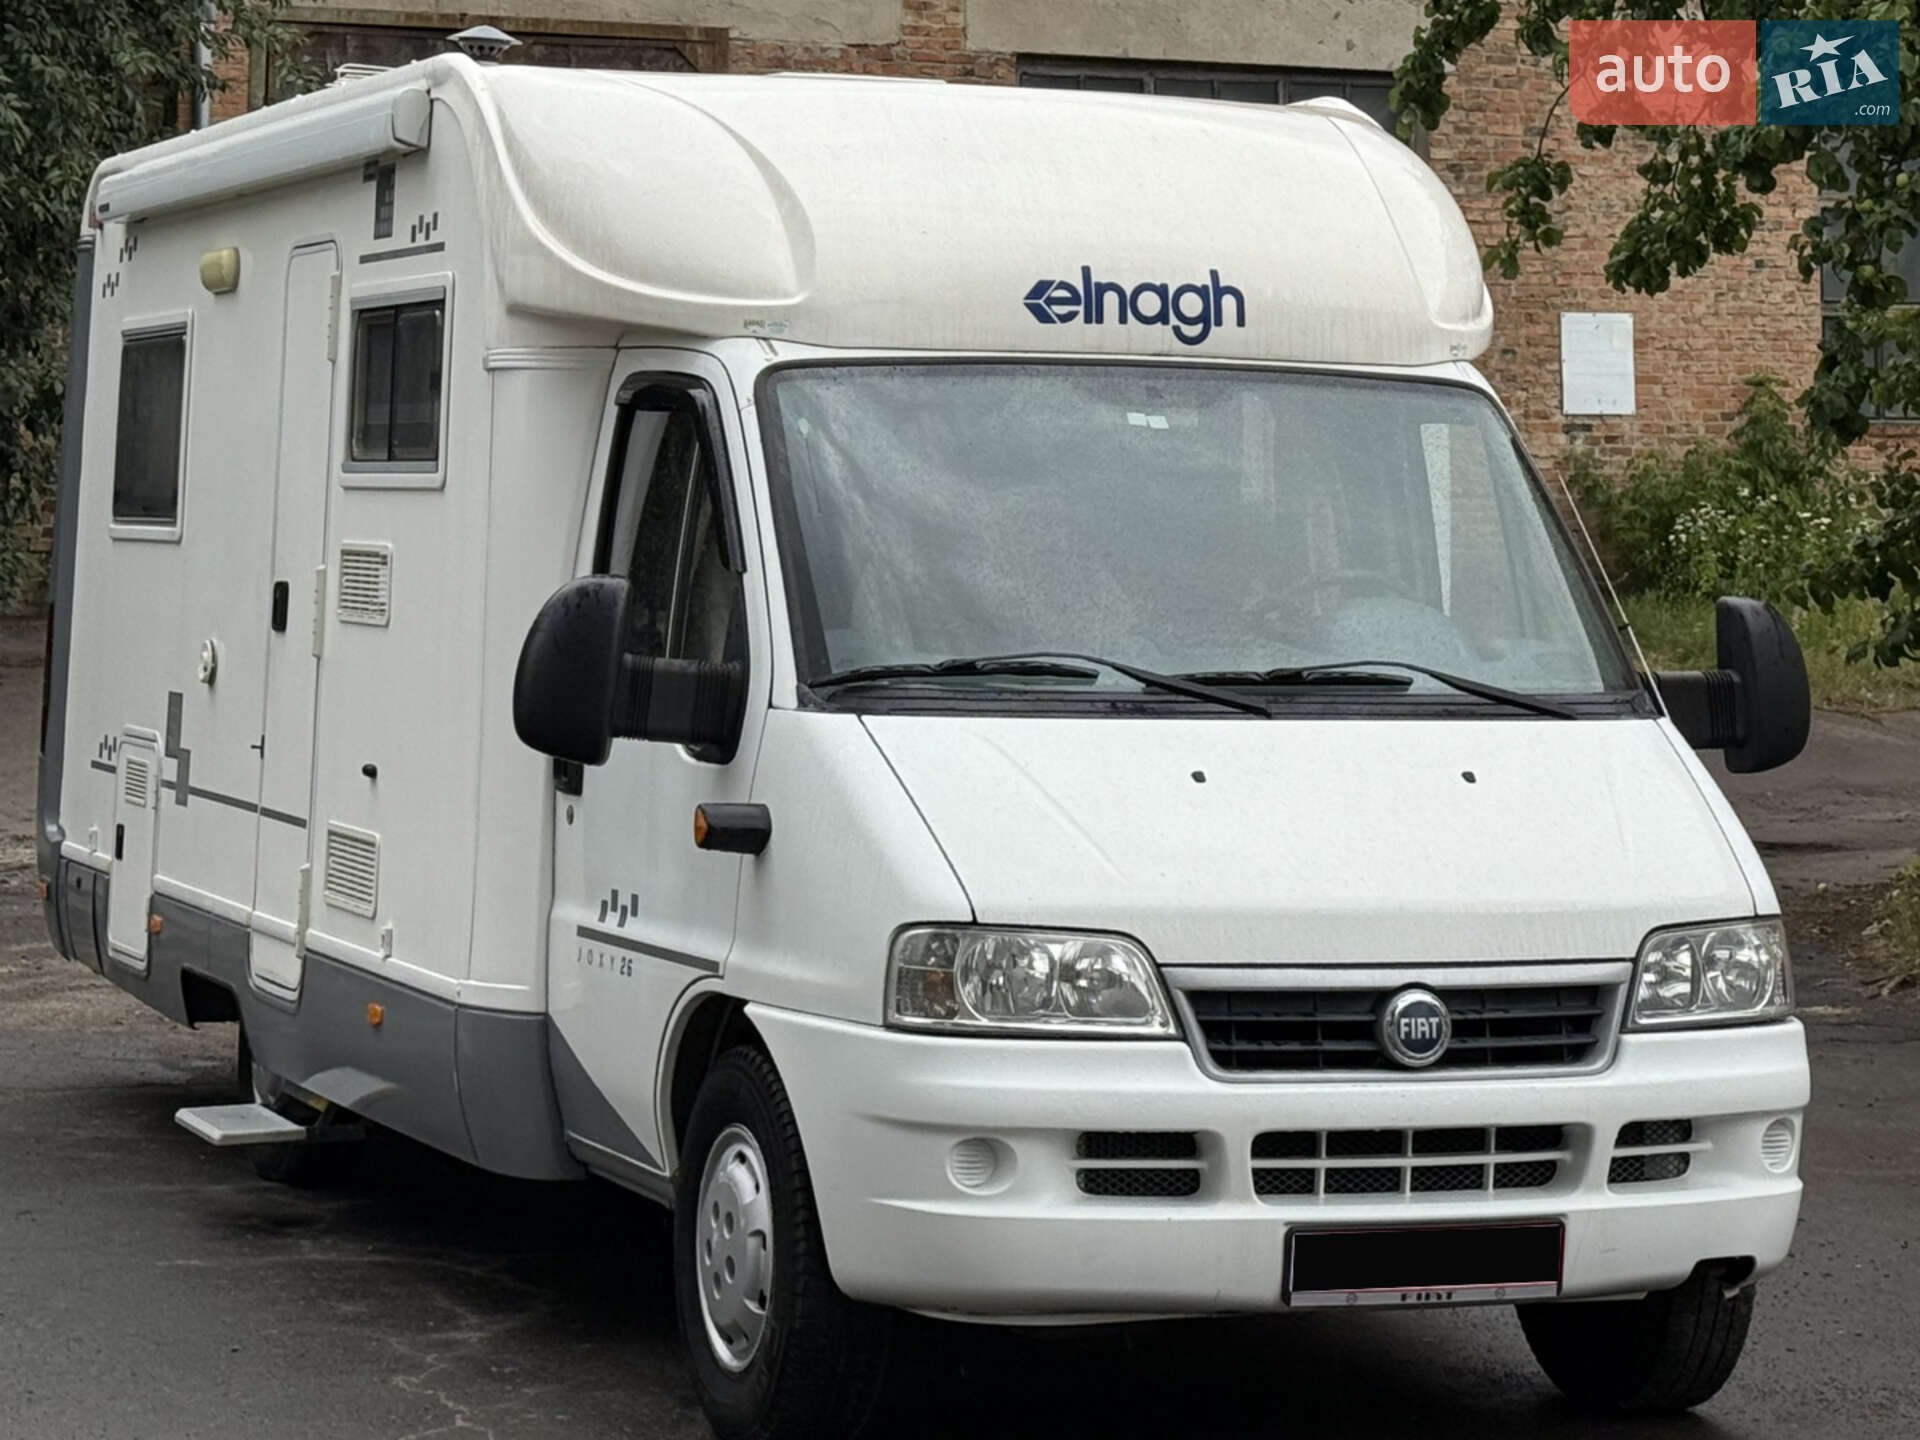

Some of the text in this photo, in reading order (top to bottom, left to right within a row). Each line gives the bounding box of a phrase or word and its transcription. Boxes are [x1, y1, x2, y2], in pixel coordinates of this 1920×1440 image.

[1046, 265, 1245, 346] elnagh
[620, 956, 632, 977] 26
[1400, 1017, 1439, 1039] FIAT
